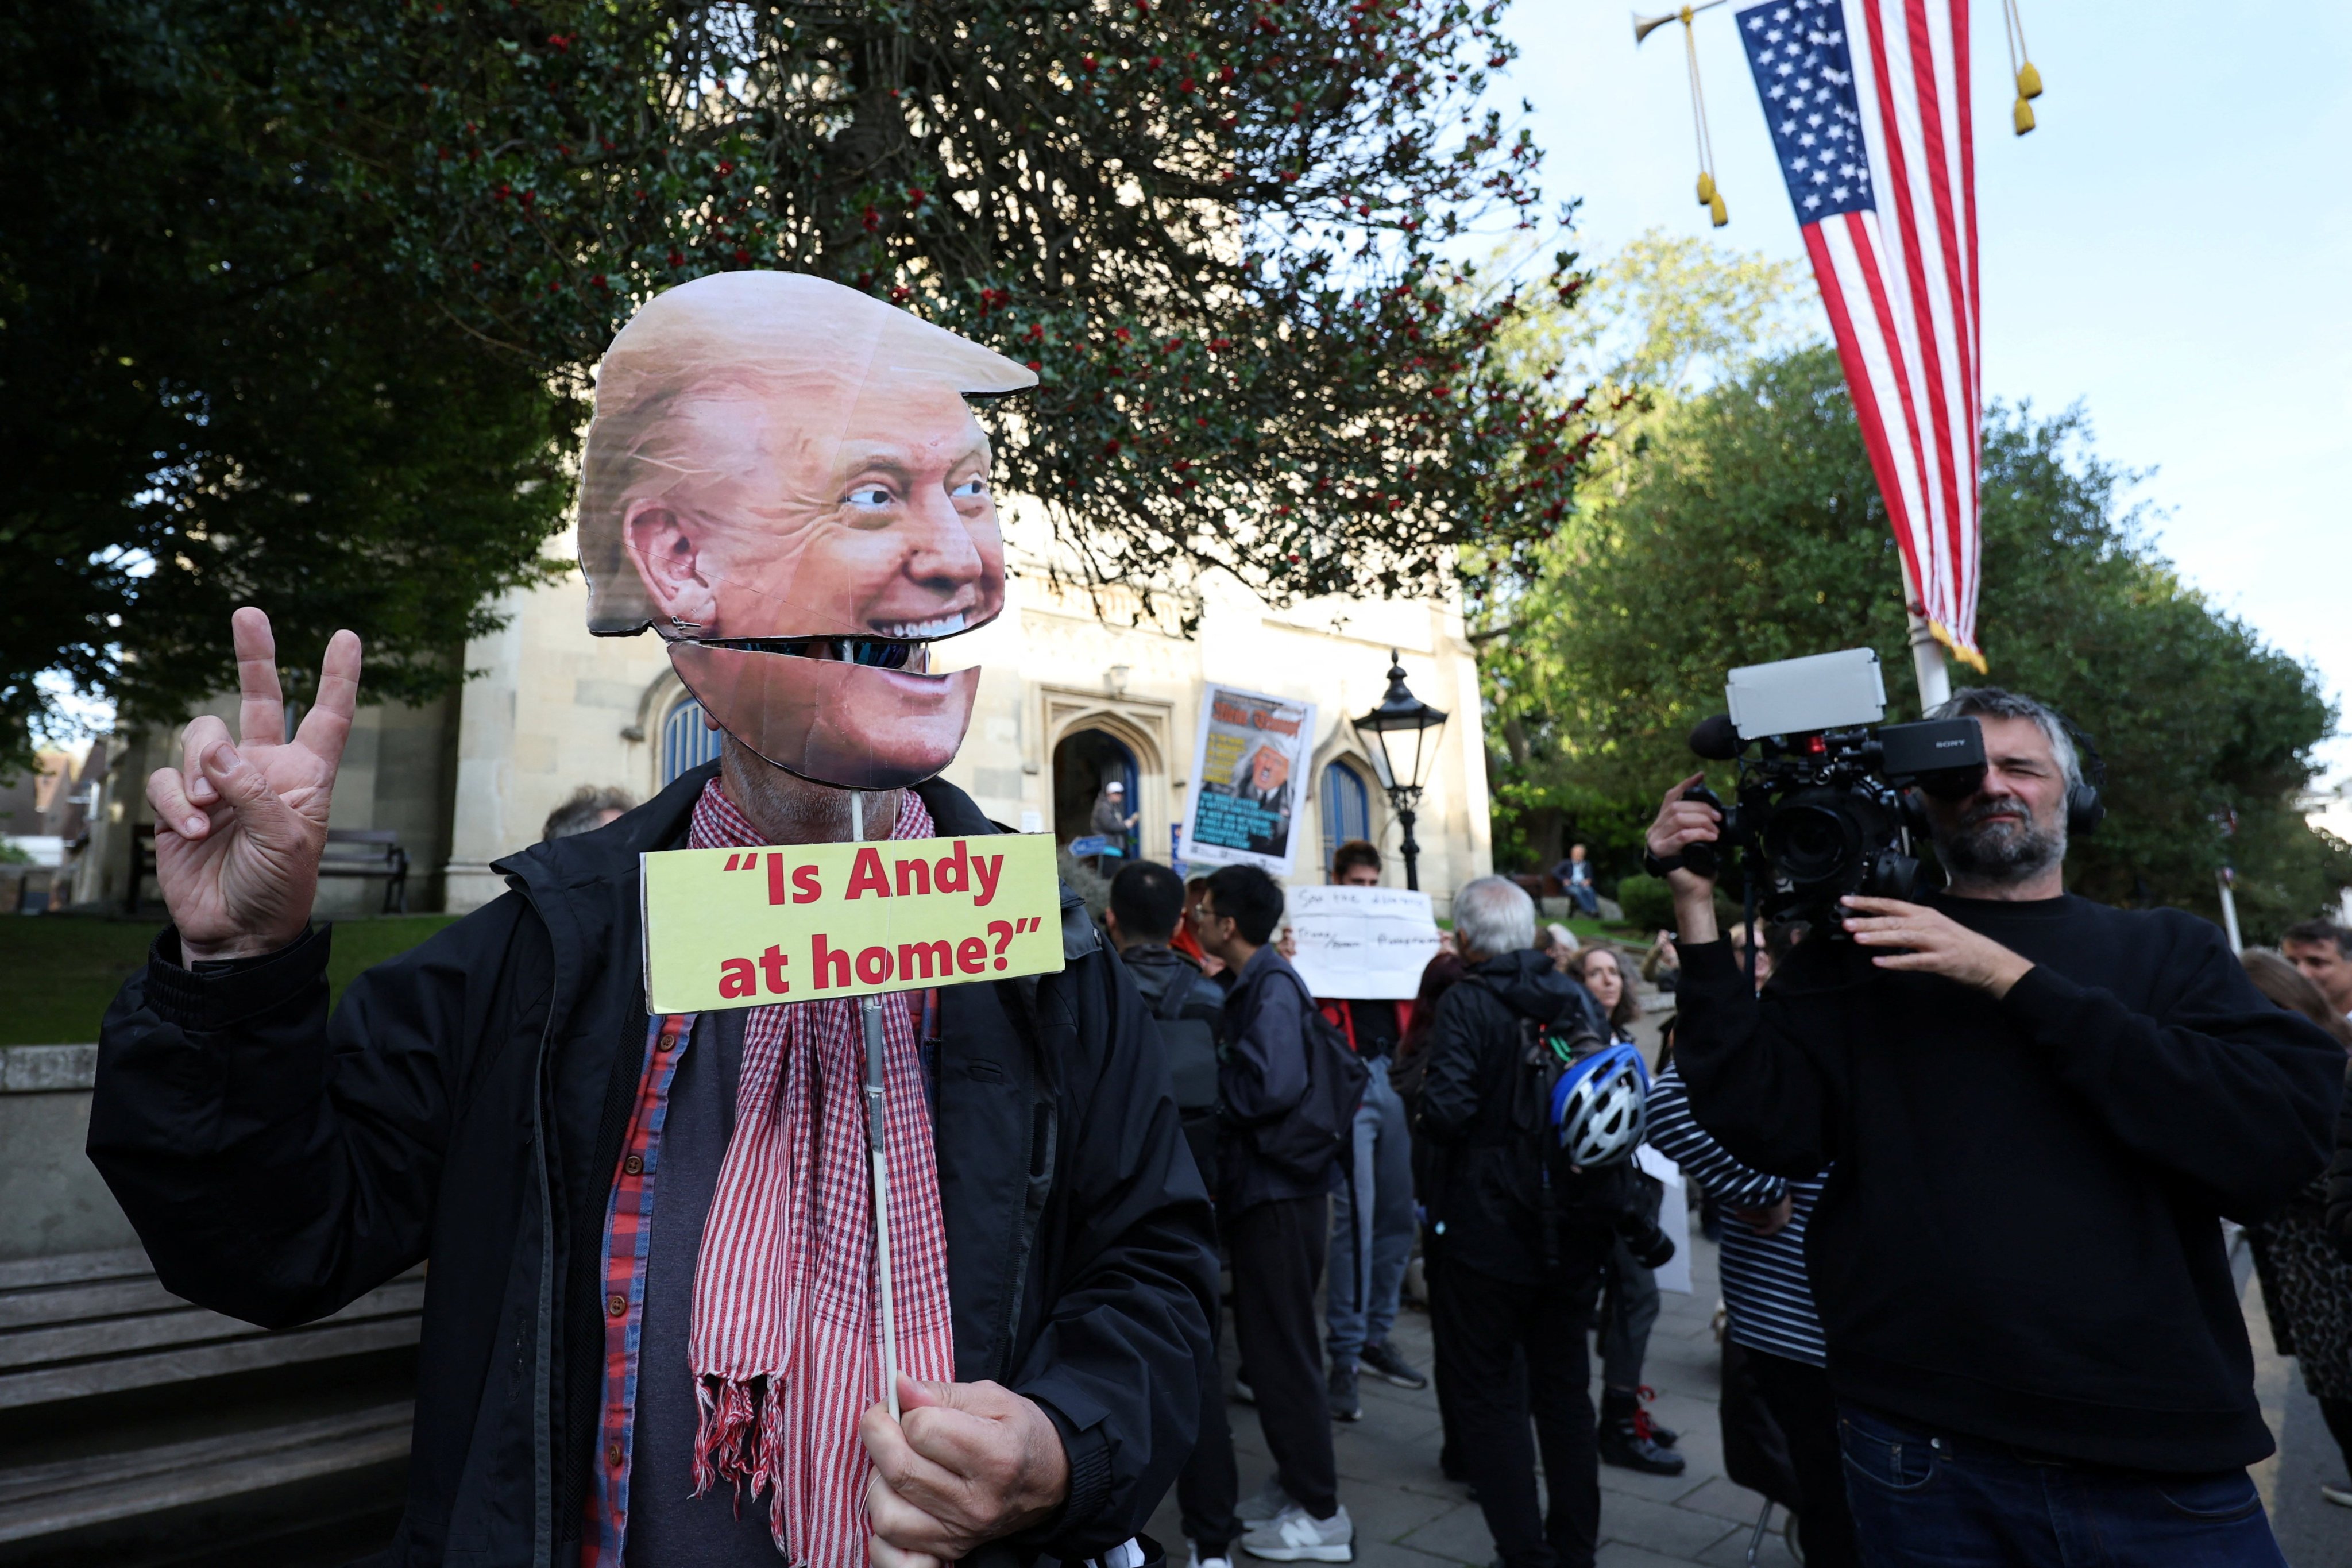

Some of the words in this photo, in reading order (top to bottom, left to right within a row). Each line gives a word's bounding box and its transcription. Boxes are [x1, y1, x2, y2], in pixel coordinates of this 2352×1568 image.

[1936, 739, 1965, 749] SONY
[845, 840, 1003, 906] Andy
[719, 945, 789, 998] at
